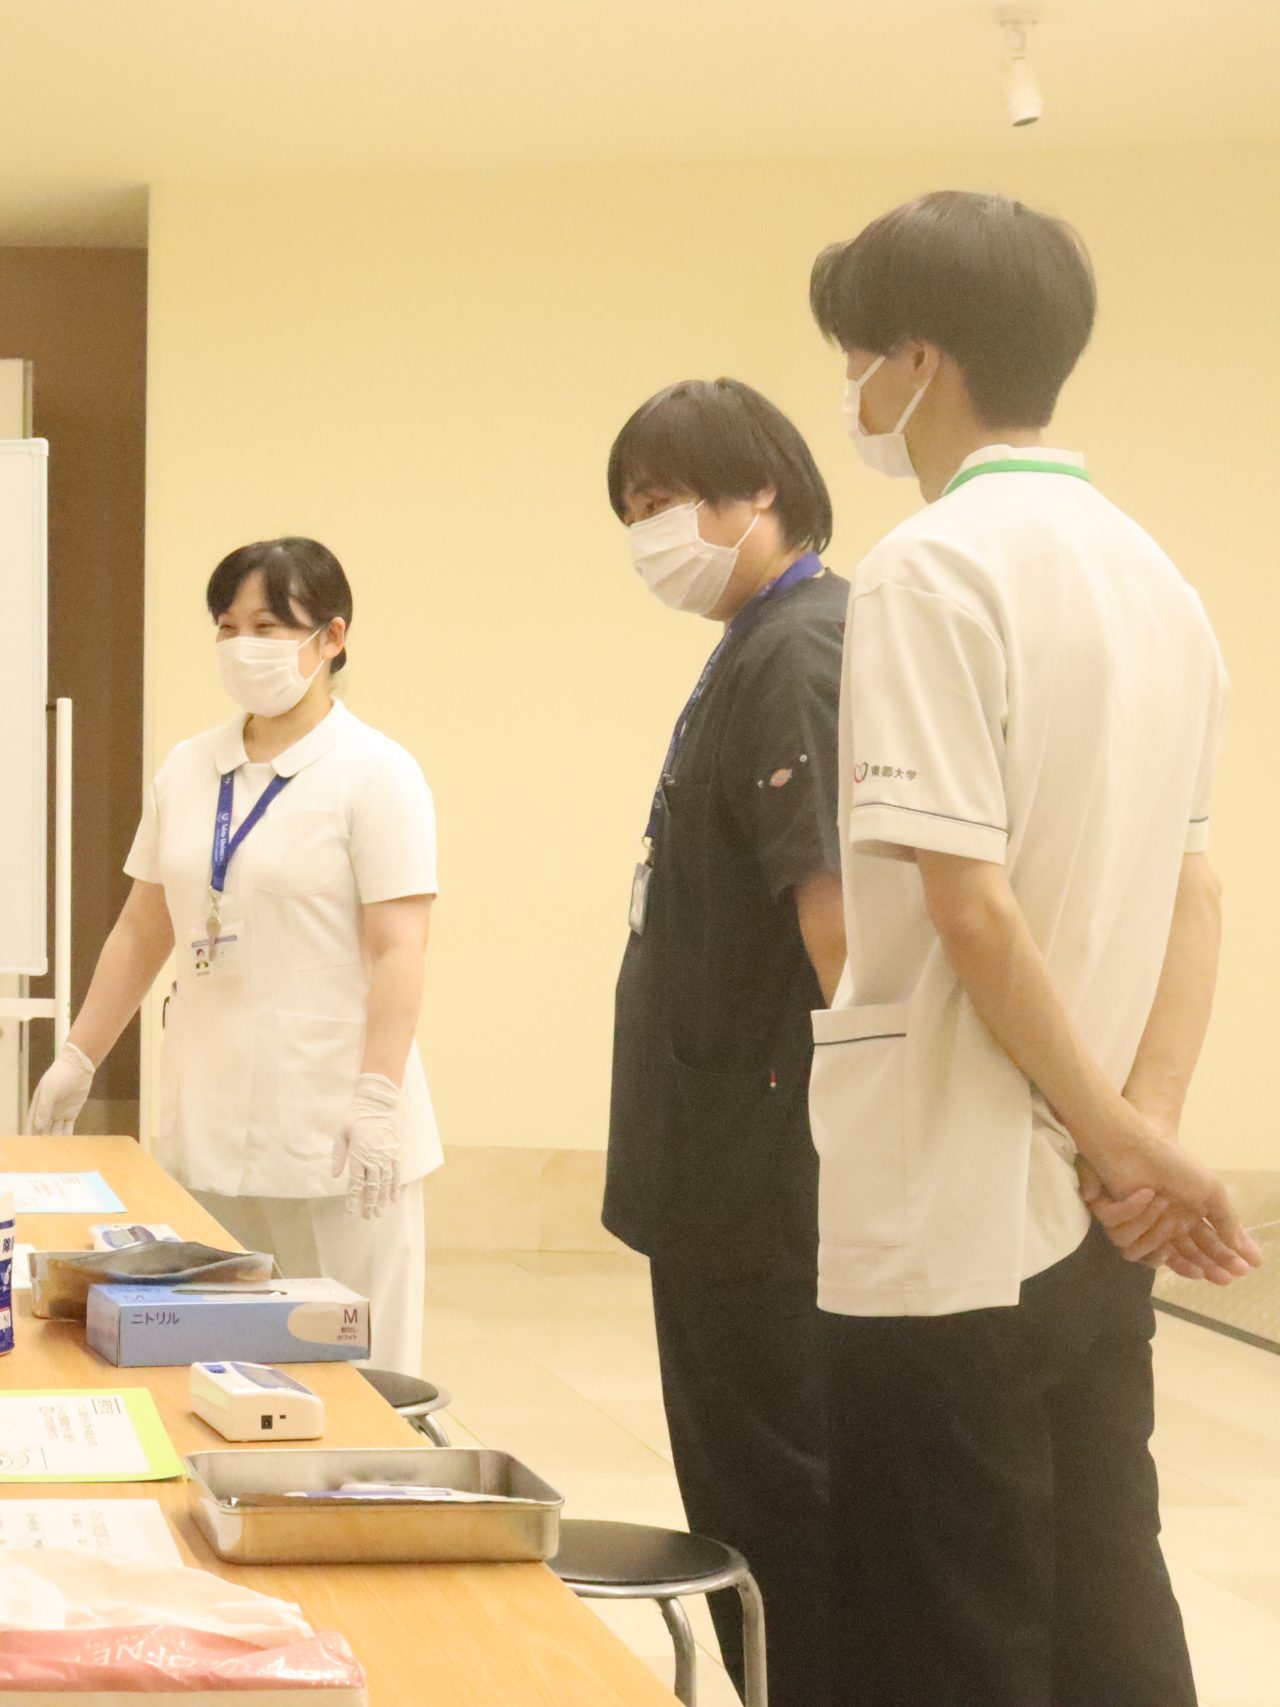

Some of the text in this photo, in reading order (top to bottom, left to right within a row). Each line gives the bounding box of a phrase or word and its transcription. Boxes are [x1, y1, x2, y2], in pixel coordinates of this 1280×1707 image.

[131, 1311, 180, 1326] ニトリル
[343, 1309, 358, 1324] M
